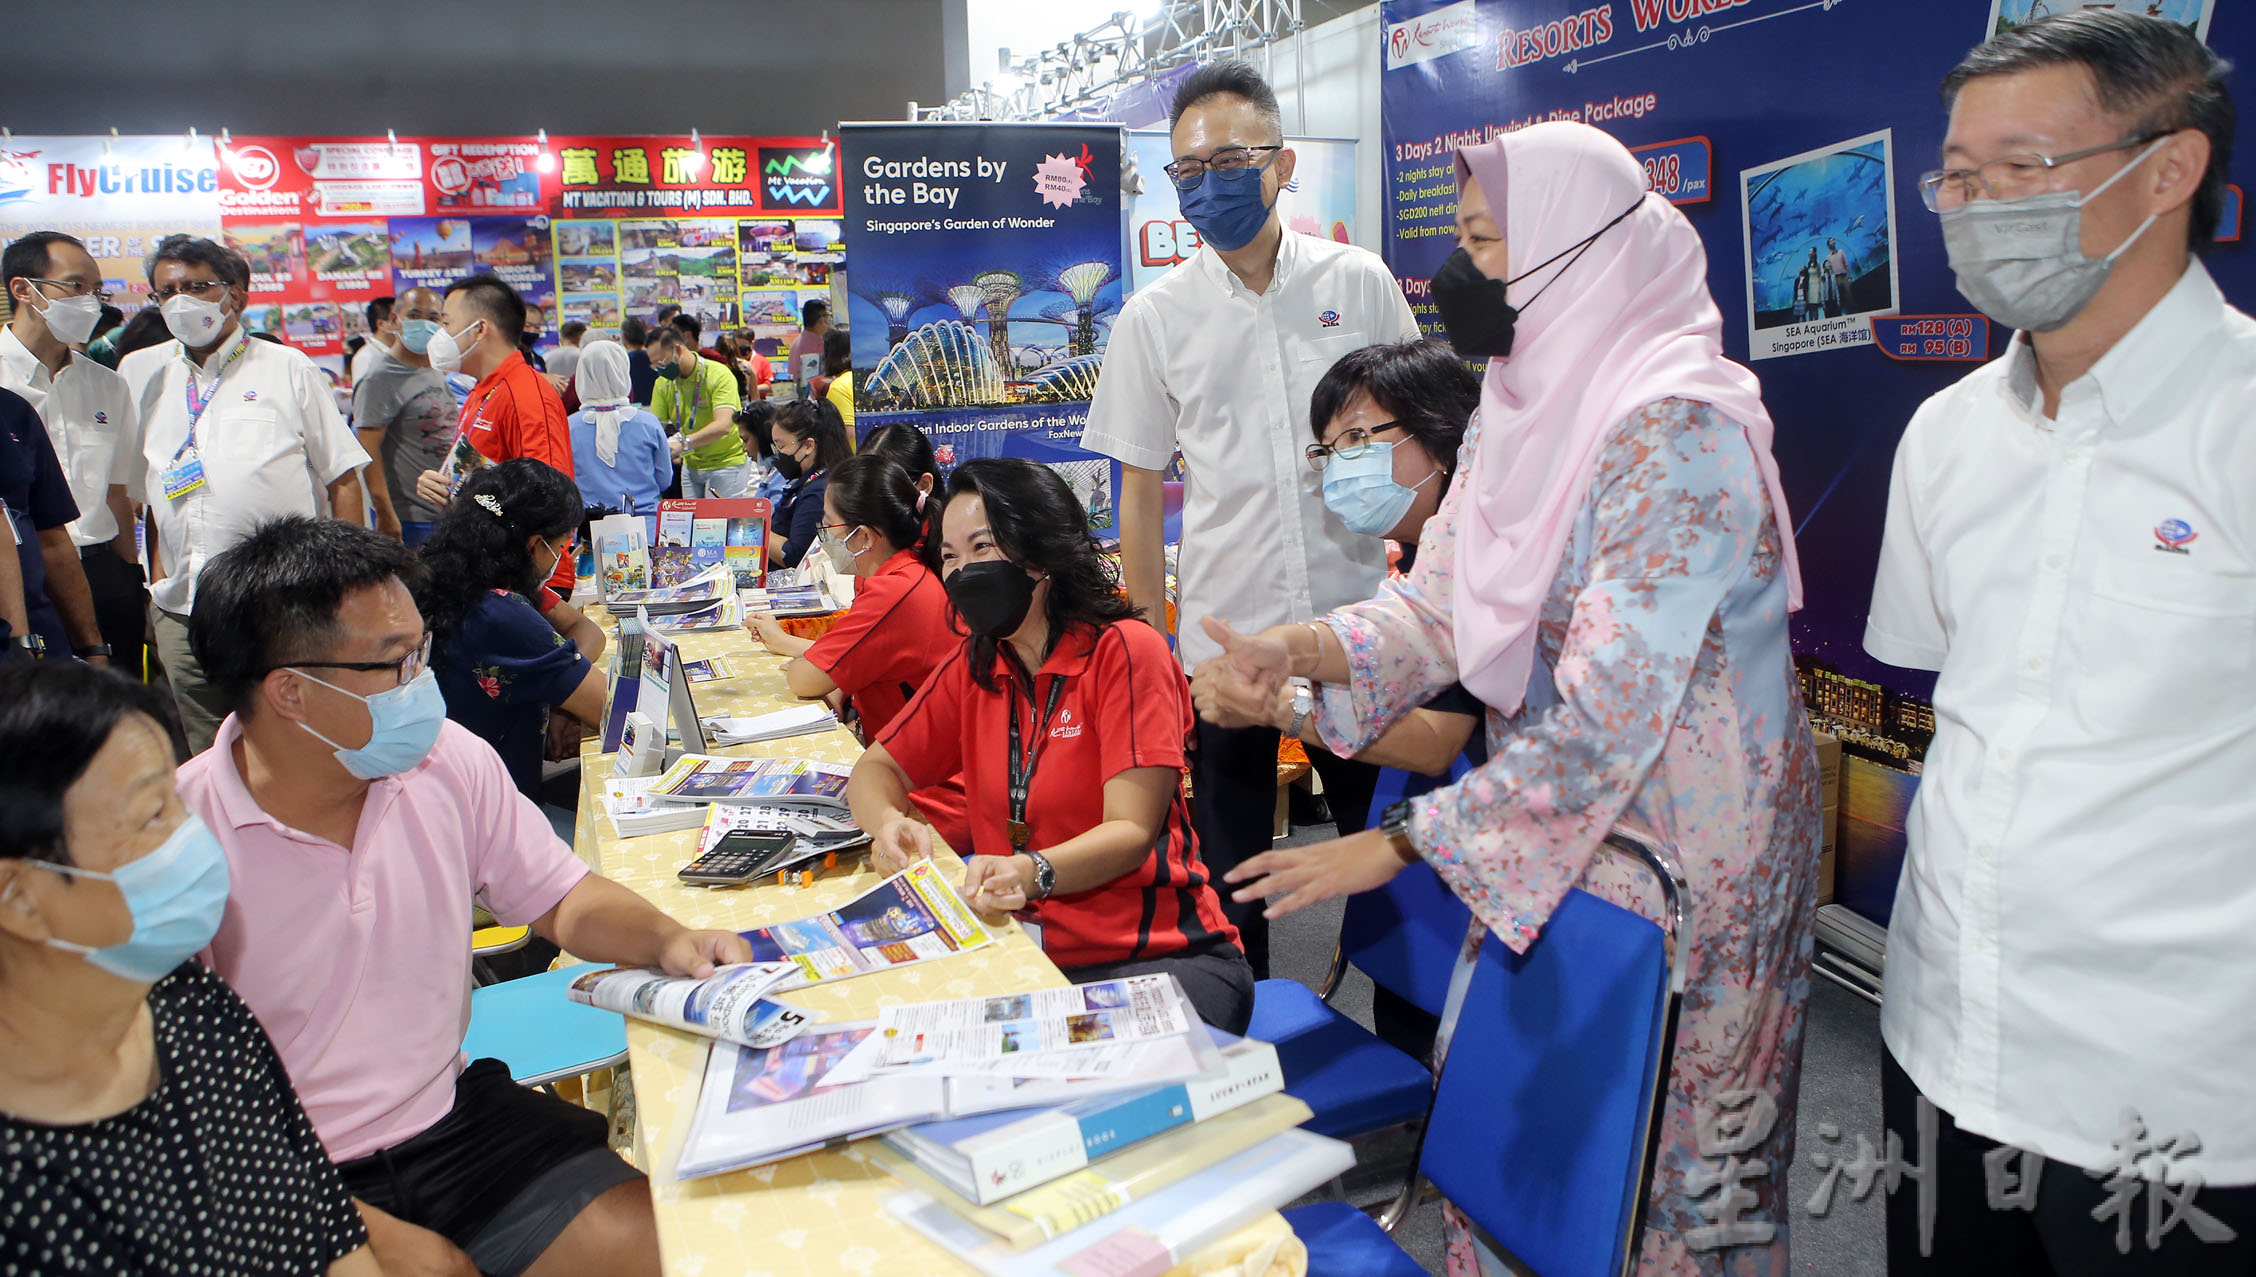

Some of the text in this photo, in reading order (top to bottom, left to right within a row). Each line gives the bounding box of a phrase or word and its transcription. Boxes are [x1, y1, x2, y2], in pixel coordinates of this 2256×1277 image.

[1496, 4, 1613, 71] RESORTS
[1396, 145, 1402, 162] 3
[1405, 143, 1432, 161] Days
[1435, 137, 1442, 154] 2
[1585, 93, 1656, 124] Package
[462, 144, 539, 156] REDEMPTION
[560, 147, 747, 185] 萬通旅游
[863, 156, 1007, 182] Gardens by
[1405, 168, 1427, 183] nights
[1428, 166, 1444, 178] stay
[1446, 162, 1454, 174] at
[48, 163, 218, 197] FlyCruise
[784, 177, 826, 185] Vacation
[1682, 178, 1706, 193] /pax
[219, 189, 300, 206] Golden
[864, 182, 960, 209] the Bay
[1419, 182, 1456, 198] breakfast
[563, 191, 581, 207] MT
[583, 191, 635, 207] VACATION
[646, 190, 683, 206] TOURS
[683, 190, 701, 210] (M)
[702, 190, 728, 206] SDN.
[728, 189, 753, 206] BHD.
[220, 206, 300, 215] Destinations
[1429, 204, 1444, 216] nett
[1446, 202, 1459, 214] din
[866, 217, 1055, 234] Singapore's Garden of Wonder
[1420, 225, 1437, 237] from
[1438, 225, 1456, 234] now
[1406, 279, 1432, 297] Days
[1410, 302, 1440, 317] ights sta
[1433, 321, 1447, 333] tick
[1786, 327, 1800, 337] SEA
[1901, 319, 1972, 337] RM128 (A)
[1772, 328, 1871, 353] Singapore (SEA 海洋馆)
[1900, 339, 1971, 357] RM 95 (B)
[935, 422, 974, 435] Indoor
[977, 419, 1028, 432] Gardens
[1032, 418, 1045, 429] of
[1046, 417, 1066, 428] the
[1048, 430, 1085, 439] FoxNew
[740, 807, 752, 815] 27
[759, 806, 772, 815] 28
[778, 807, 790, 816] 29
[737, 820, 749, 828] 20
[781, 1011, 805, 1025] 5
